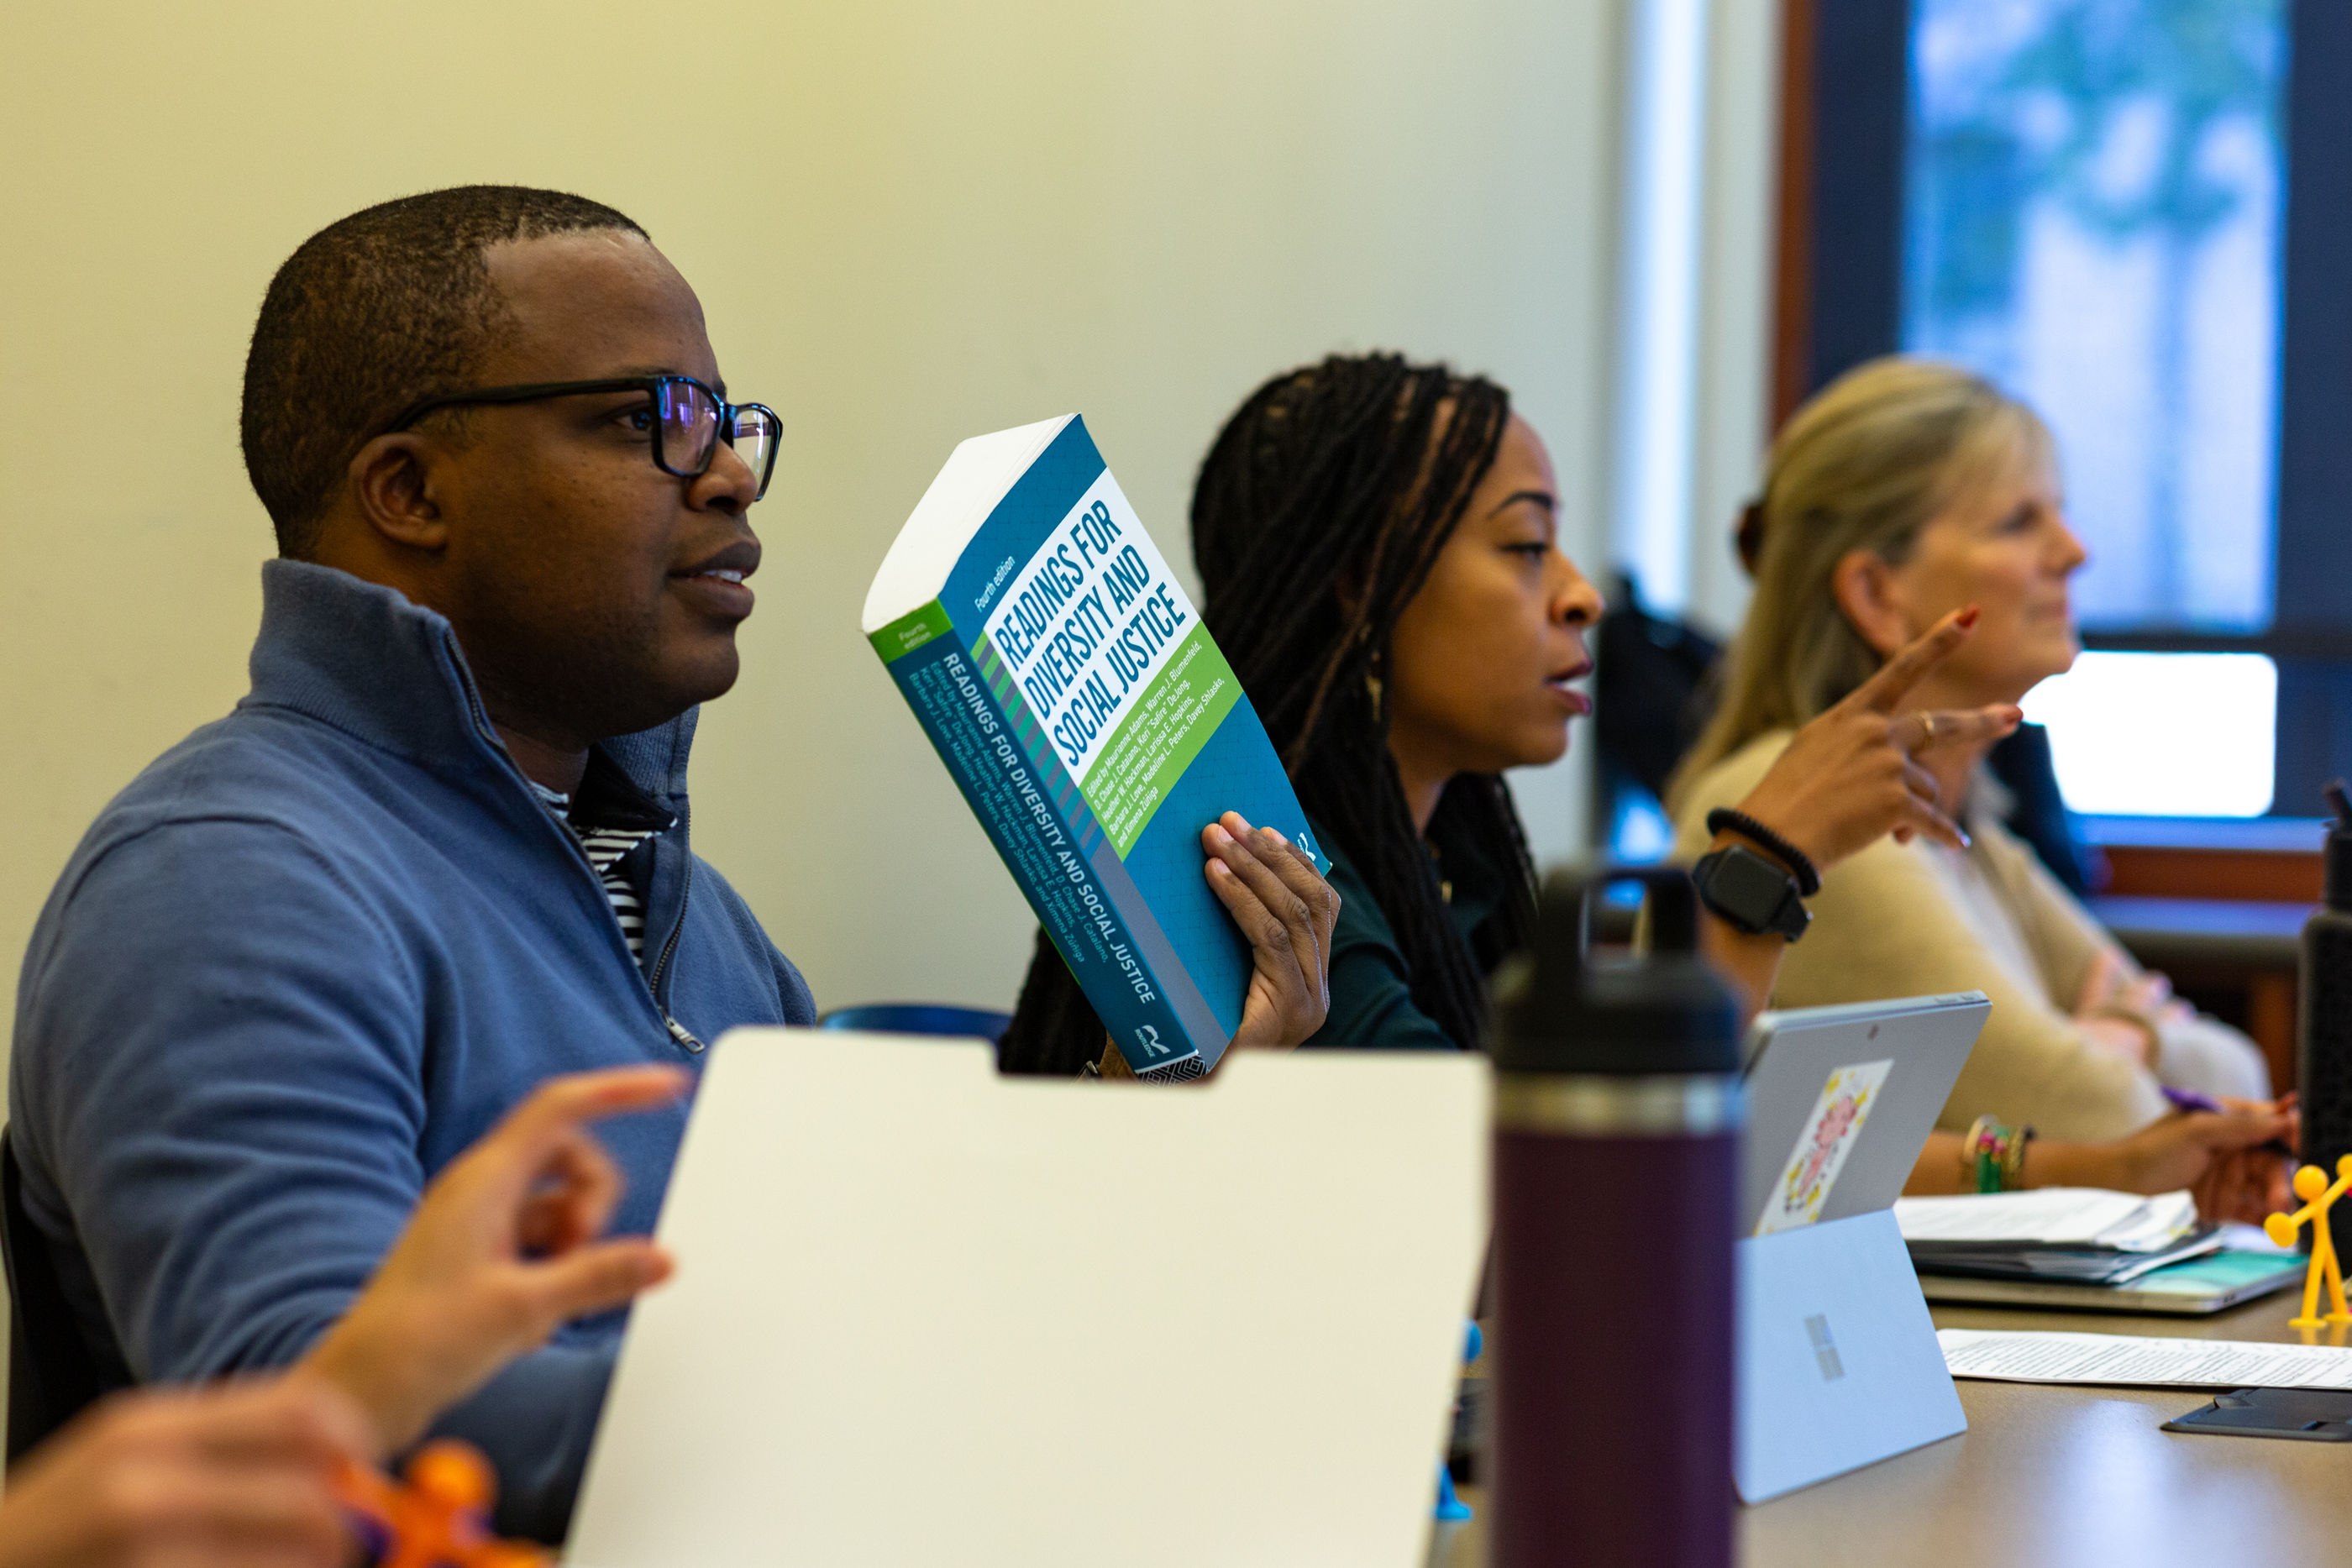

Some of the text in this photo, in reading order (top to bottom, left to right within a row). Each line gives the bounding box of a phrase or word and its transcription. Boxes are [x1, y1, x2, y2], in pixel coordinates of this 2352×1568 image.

[974, 556, 1016, 613] Fourth edition
[995, 499, 1122, 672] READINGS FOR
[1023, 543, 1150, 720] DIVERSITY AND
[1053, 581, 1186, 767] SOCIAL JUSTICE
[1086, 772, 1103, 798] Edited
[1099, 765, 1109, 779] by
[1104, 732, 1131, 769] Maurianne
[1128, 711, 1150, 737] Adams,
[1144, 684, 1168, 712] Warren
[1168, 640, 1203, 682] Blumenfeld,
[1098, 779, 1116, 803] Chase
[1116, 745, 1142, 776] Catalano,
[1136, 726, 1151, 747] Keri
[1166, 679, 1191, 706] DeJong,
[942, 652, 1155, 1004] READINGS FOR DIVERSITY AND SOCIAL JUSTICE
[1101, 793, 1121, 823] Heather
[1123, 755, 1150, 789] Hackman,
[1145, 730, 1167, 757] Larissa
[1168, 695, 1194, 726] Hopkins,
[1108, 805, 1129, 836] Barbara
[1129, 784, 1146, 803] Love,
[1141, 753, 1166, 785] Madeline
[1168, 723, 1190, 749] Peters,
[1185, 701, 1205, 726] Davey
[1200, 678, 1225, 706] Shlasko,
[1117, 829, 1128, 848] and
[1123, 808, 1143, 836] Ximena
[1134, 1028, 1156, 1057] ROUTLEDGE
